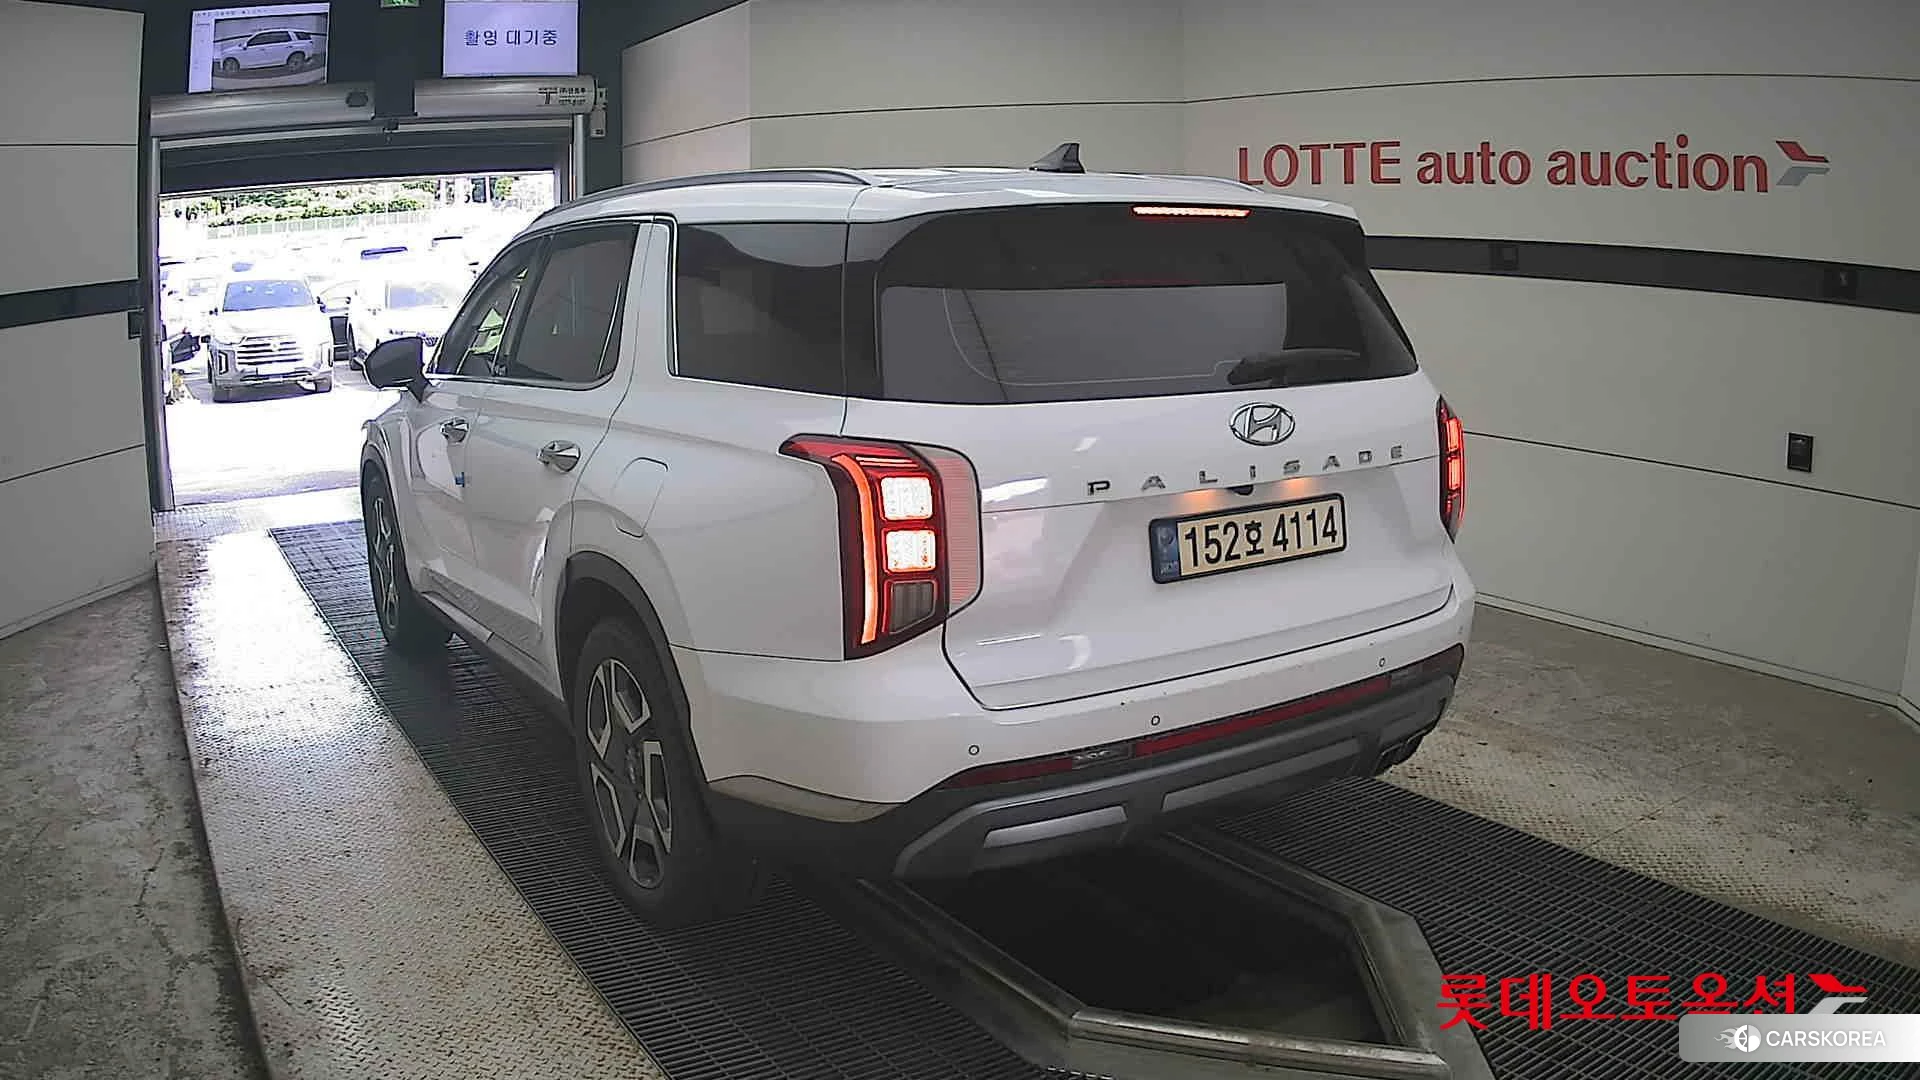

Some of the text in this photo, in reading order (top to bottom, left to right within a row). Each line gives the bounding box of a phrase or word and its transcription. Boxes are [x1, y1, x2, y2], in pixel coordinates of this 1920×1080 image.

[506, 29, 558, 46] 대기중
[1238, 133, 1768, 193] LOTTE auto auction
[1087, 445, 1403, 496] PALISADE
[1184, 505, 1339, 568] 152호 4114
